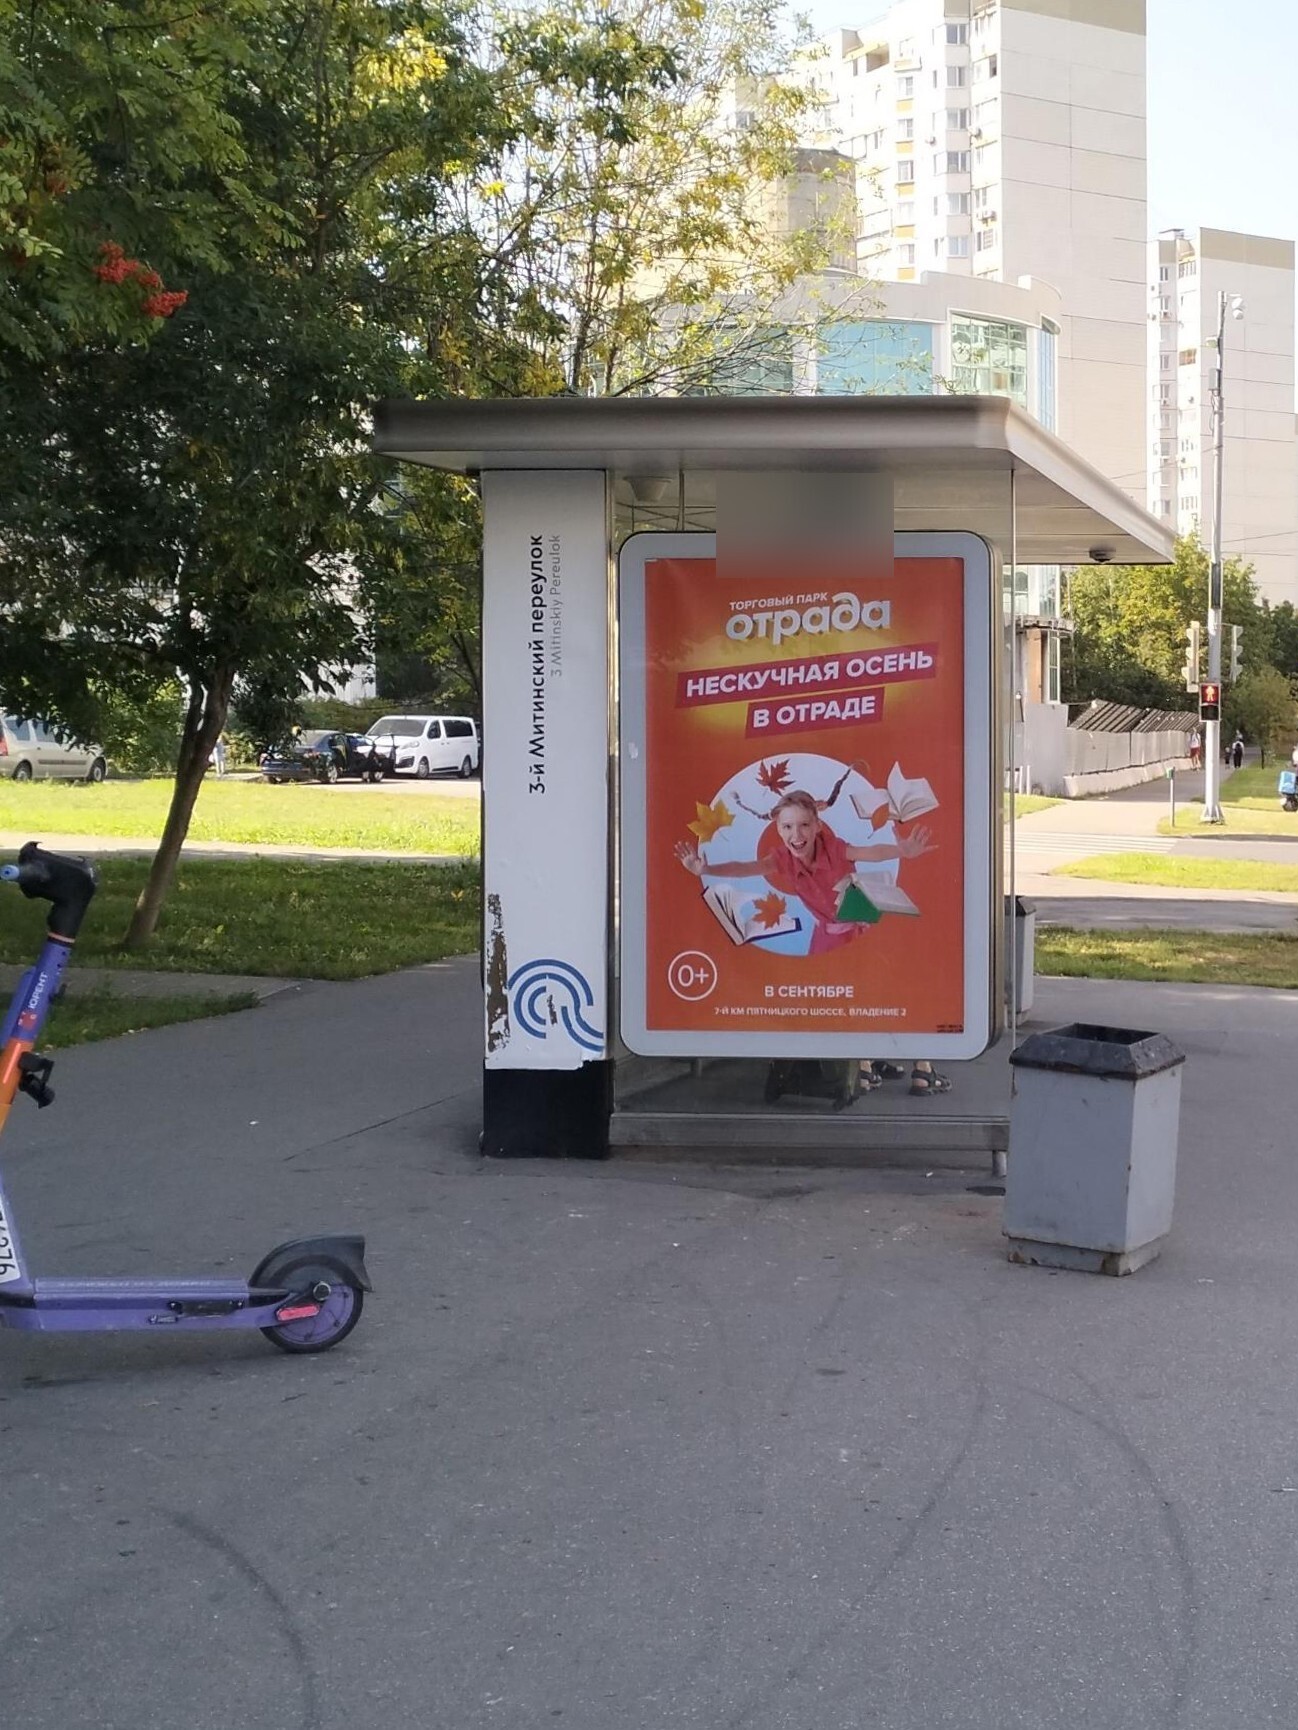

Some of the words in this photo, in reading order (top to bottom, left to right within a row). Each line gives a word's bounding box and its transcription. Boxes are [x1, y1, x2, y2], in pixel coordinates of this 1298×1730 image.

[548, 535, 561, 595] Pereulok
[530, 535, 548, 633] переулок
[729, 594, 794, 611] ТОРГОВЫЙ
[796, 592, 829, 605] ПАРК
[725, 592, 891, 645] отрада
[550, 668, 563, 677] 3
[686, 660, 840, 698] НЕСКУЧНАЯ
[845, 650, 933, 678] ОСЕНЬ
[528, 639, 546, 758] Митинский
[752, 709, 770, 729] В
[775, 695, 876, 723] ОТРАДЕ
[528, 763, 546, 794] 3-й
[677, 964, 709, 987] 0+
[764, 985, 775, 998] В
[777, 985, 855, 999] СЕНТЯБРЕ
[714, 1006, 729, 1016] 7-Й
[730, 1006, 745, 1016] КМ
[746, 1006, 808, 1017] ПЯТНИЦКОГО
[809, 1007, 846, 1017] ШОССЕ,
[848, 1007, 899, 1018] ВЛАДЕНИЕ
[900, 1007, 907, 1016] 2
